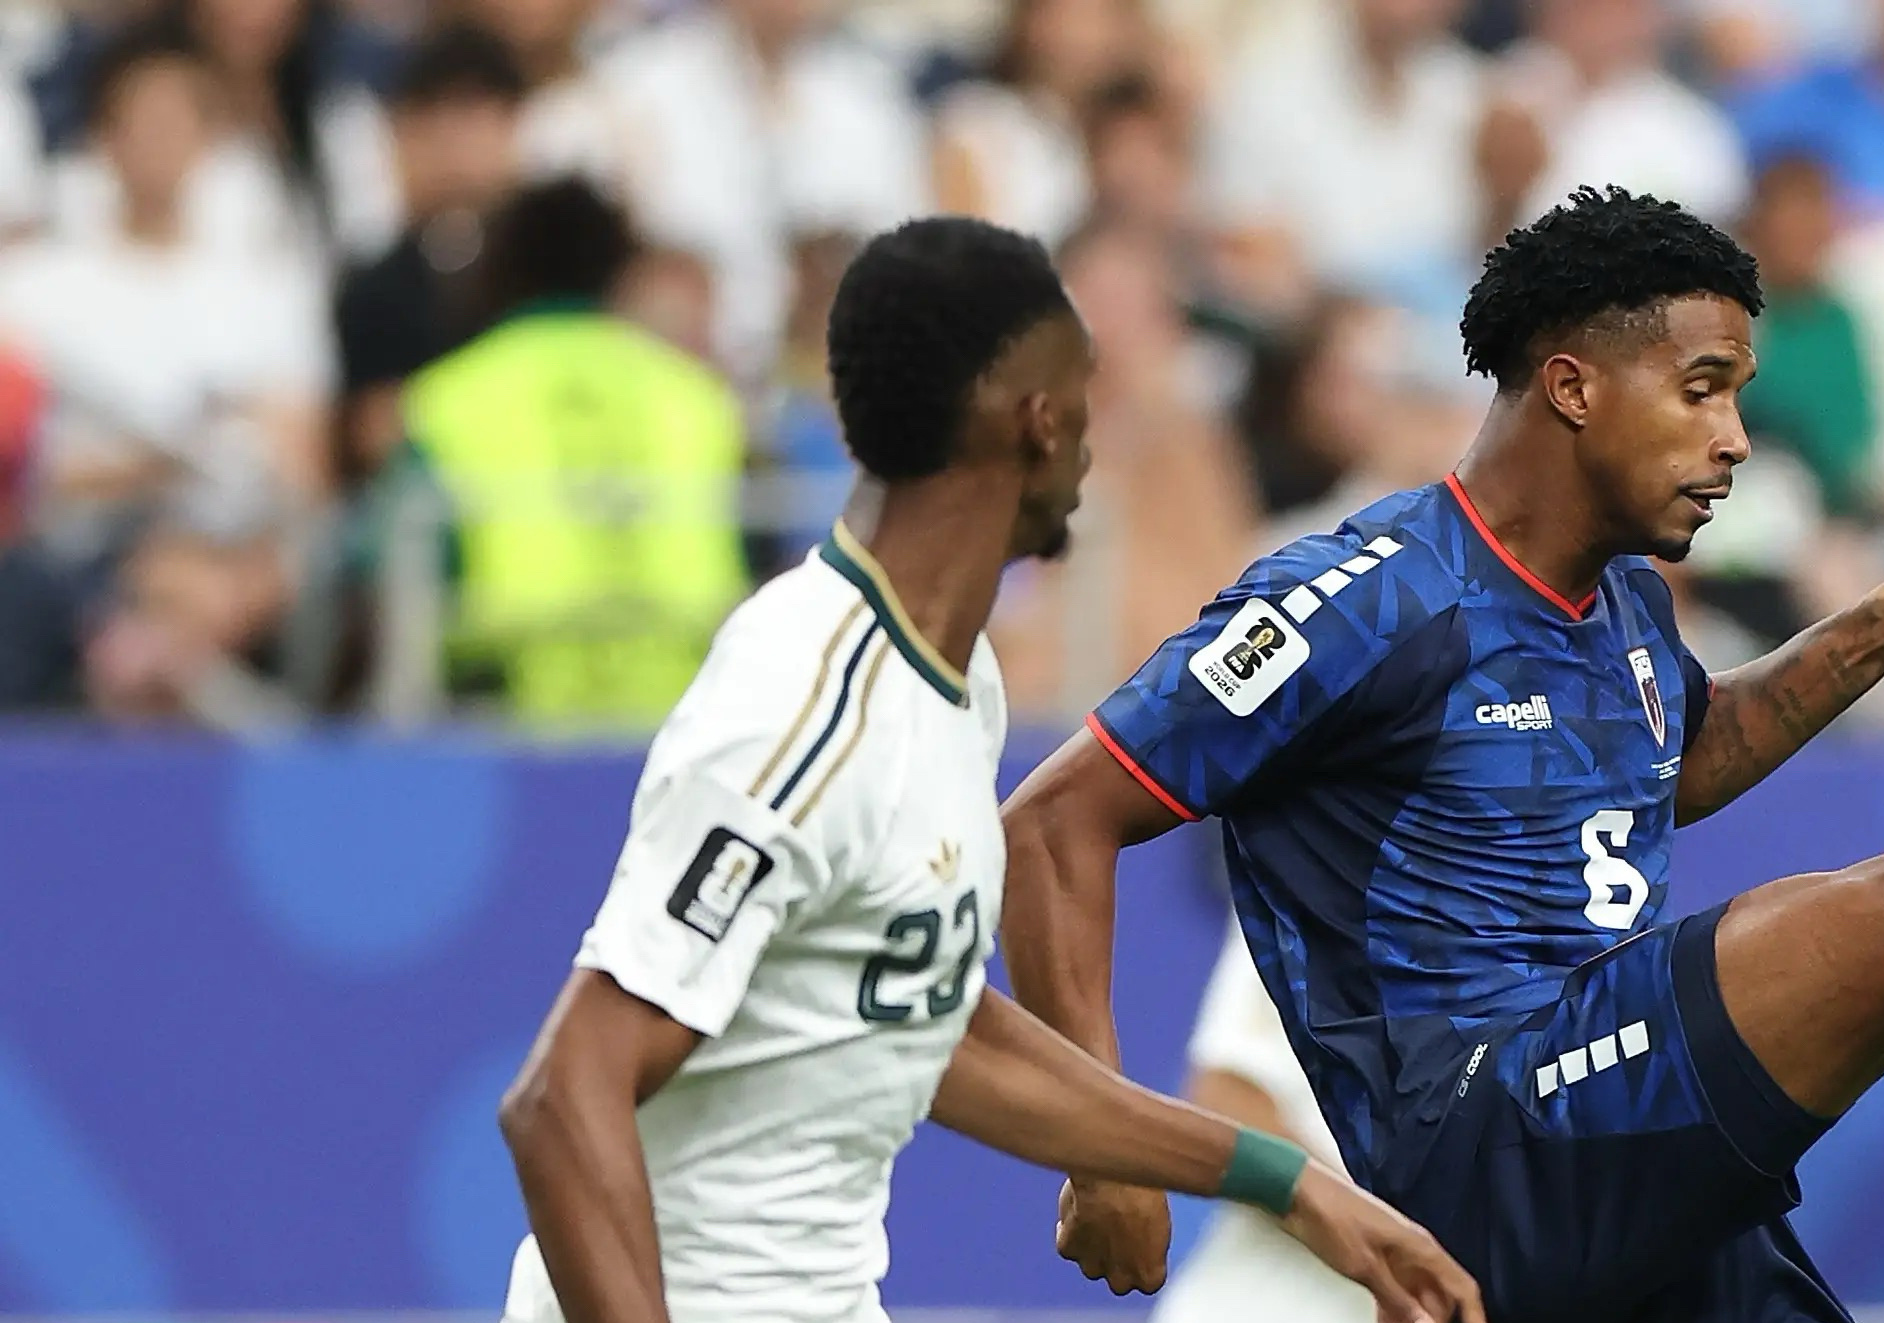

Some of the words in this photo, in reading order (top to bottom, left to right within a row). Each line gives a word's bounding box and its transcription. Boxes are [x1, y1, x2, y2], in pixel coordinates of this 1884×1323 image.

[1204, 666, 1235, 697] 2026
[1475, 695, 1552, 729] capelli
[1516, 720, 1552, 731] SPORT
[1581, 810, 1650, 930] 6
